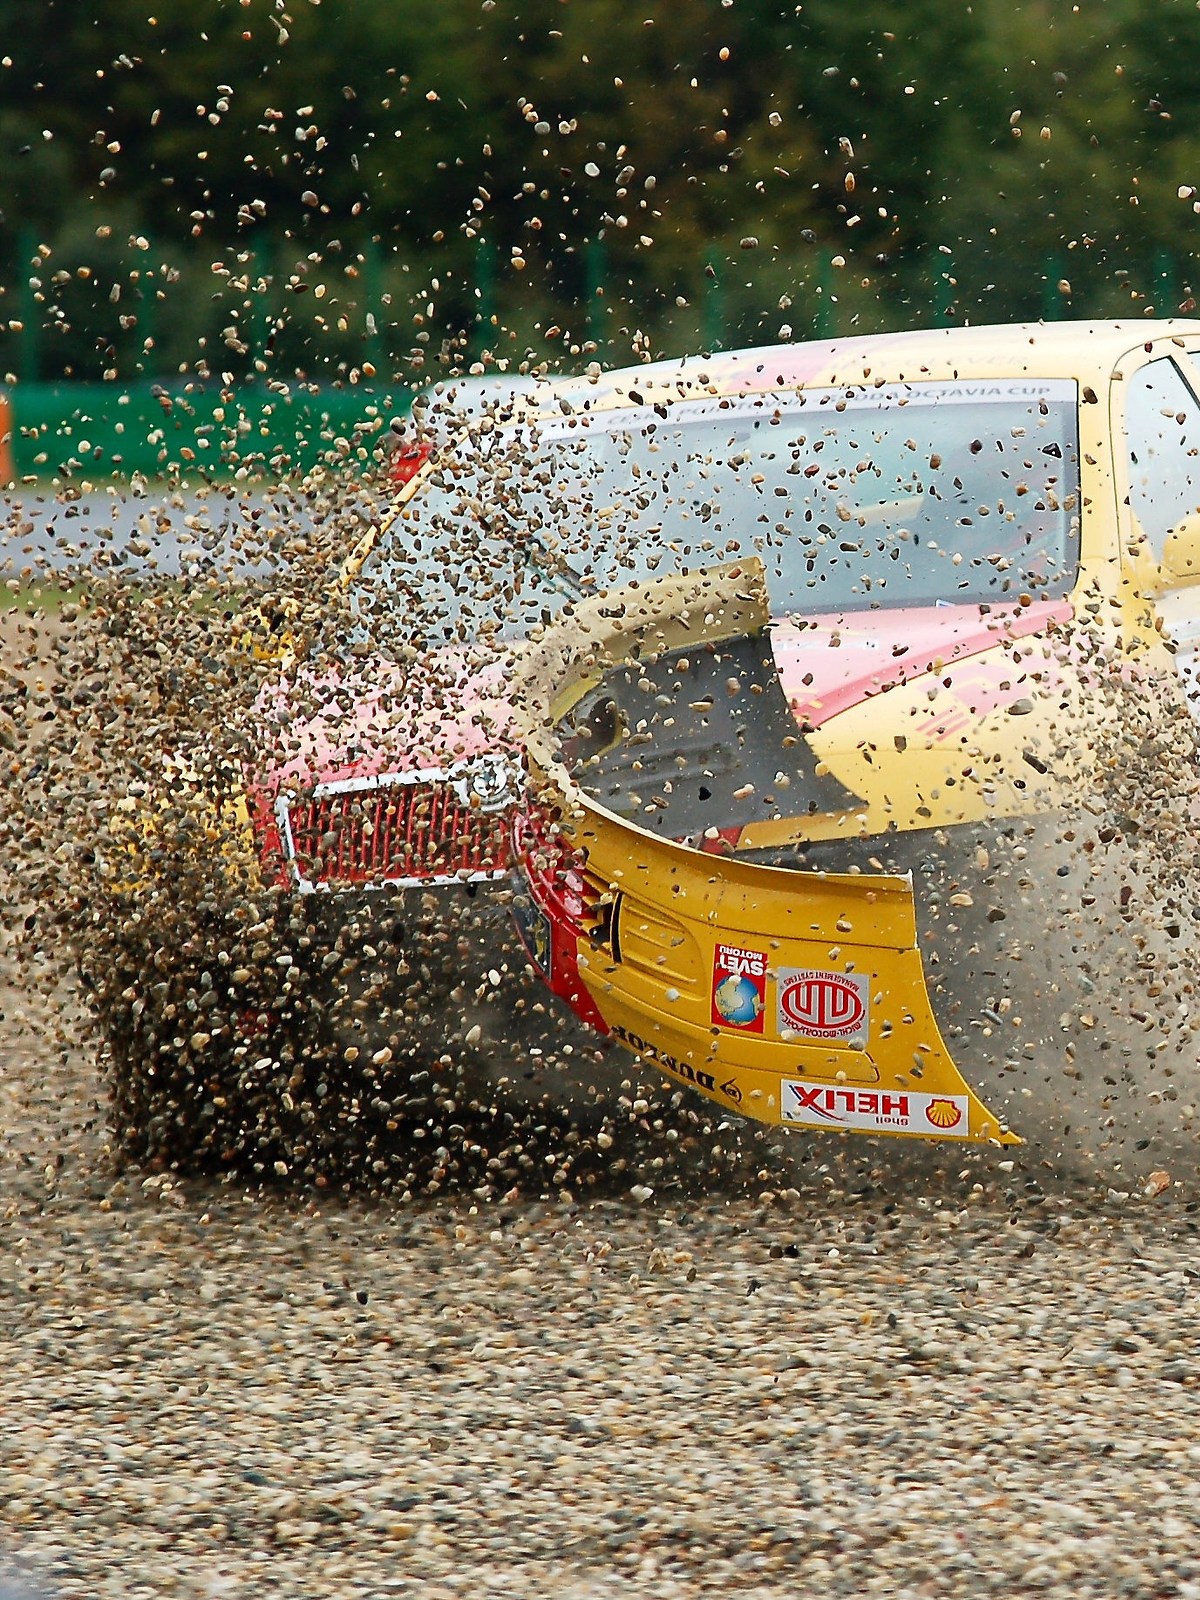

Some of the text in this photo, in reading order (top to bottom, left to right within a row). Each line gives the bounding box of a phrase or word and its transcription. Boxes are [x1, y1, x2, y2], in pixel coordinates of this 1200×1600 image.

[906, 386, 1001, 399] OCTAVIA
[1008, 386, 1051, 396] CUP
[784, 971, 860, 992] MANAGEMENT SYSTEMS
[793, 1085, 910, 1117] HELIX
[876, 1116, 908, 1126] Shell
